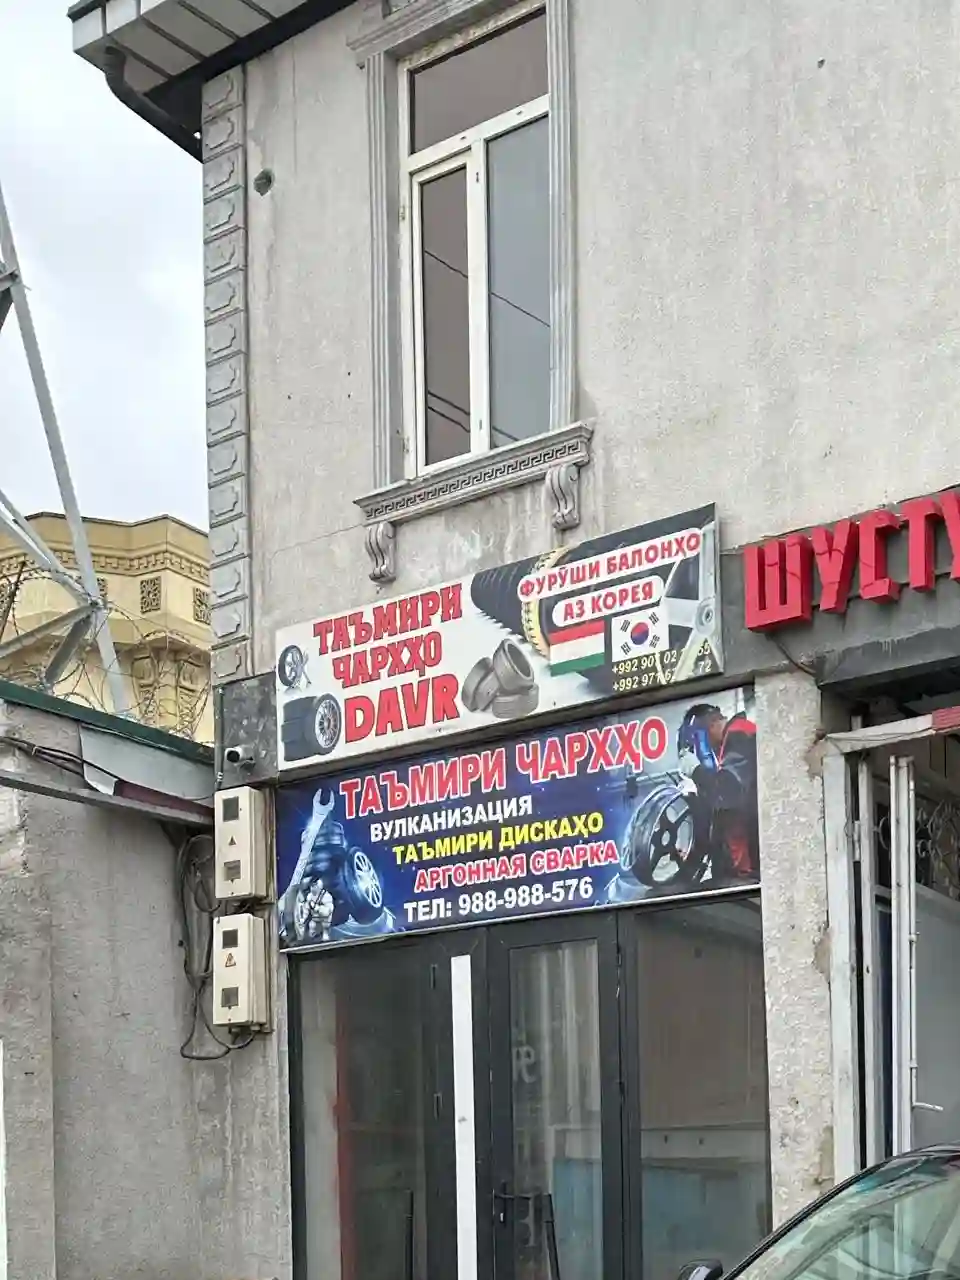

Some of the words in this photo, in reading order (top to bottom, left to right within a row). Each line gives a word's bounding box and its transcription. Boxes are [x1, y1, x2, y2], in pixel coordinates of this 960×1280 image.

[313, 583, 462, 656] ТАЪМИРИ
[564, 600, 587, 623] АЗ
[591, 582, 654, 616] КОРЕЯ
[612, 659, 638, 674] +992
[613, 676, 639, 691] +992
[344, 674, 460, 744] DAVR
[340, 747, 508, 819] ТАЪМИРИ
[370, 795, 533, 842] ВУЛКАНИЗАЦИЯ
[393, 825, 495, 866] ТАЪМИРИ
[414, 849, 527, 893] АРГОННАЯ
[531, 839, 619, 876] СВАРКА
[404, 898, 453, 924] ТЕЛ:
[458, 876, 594, 916] 988-988-576
